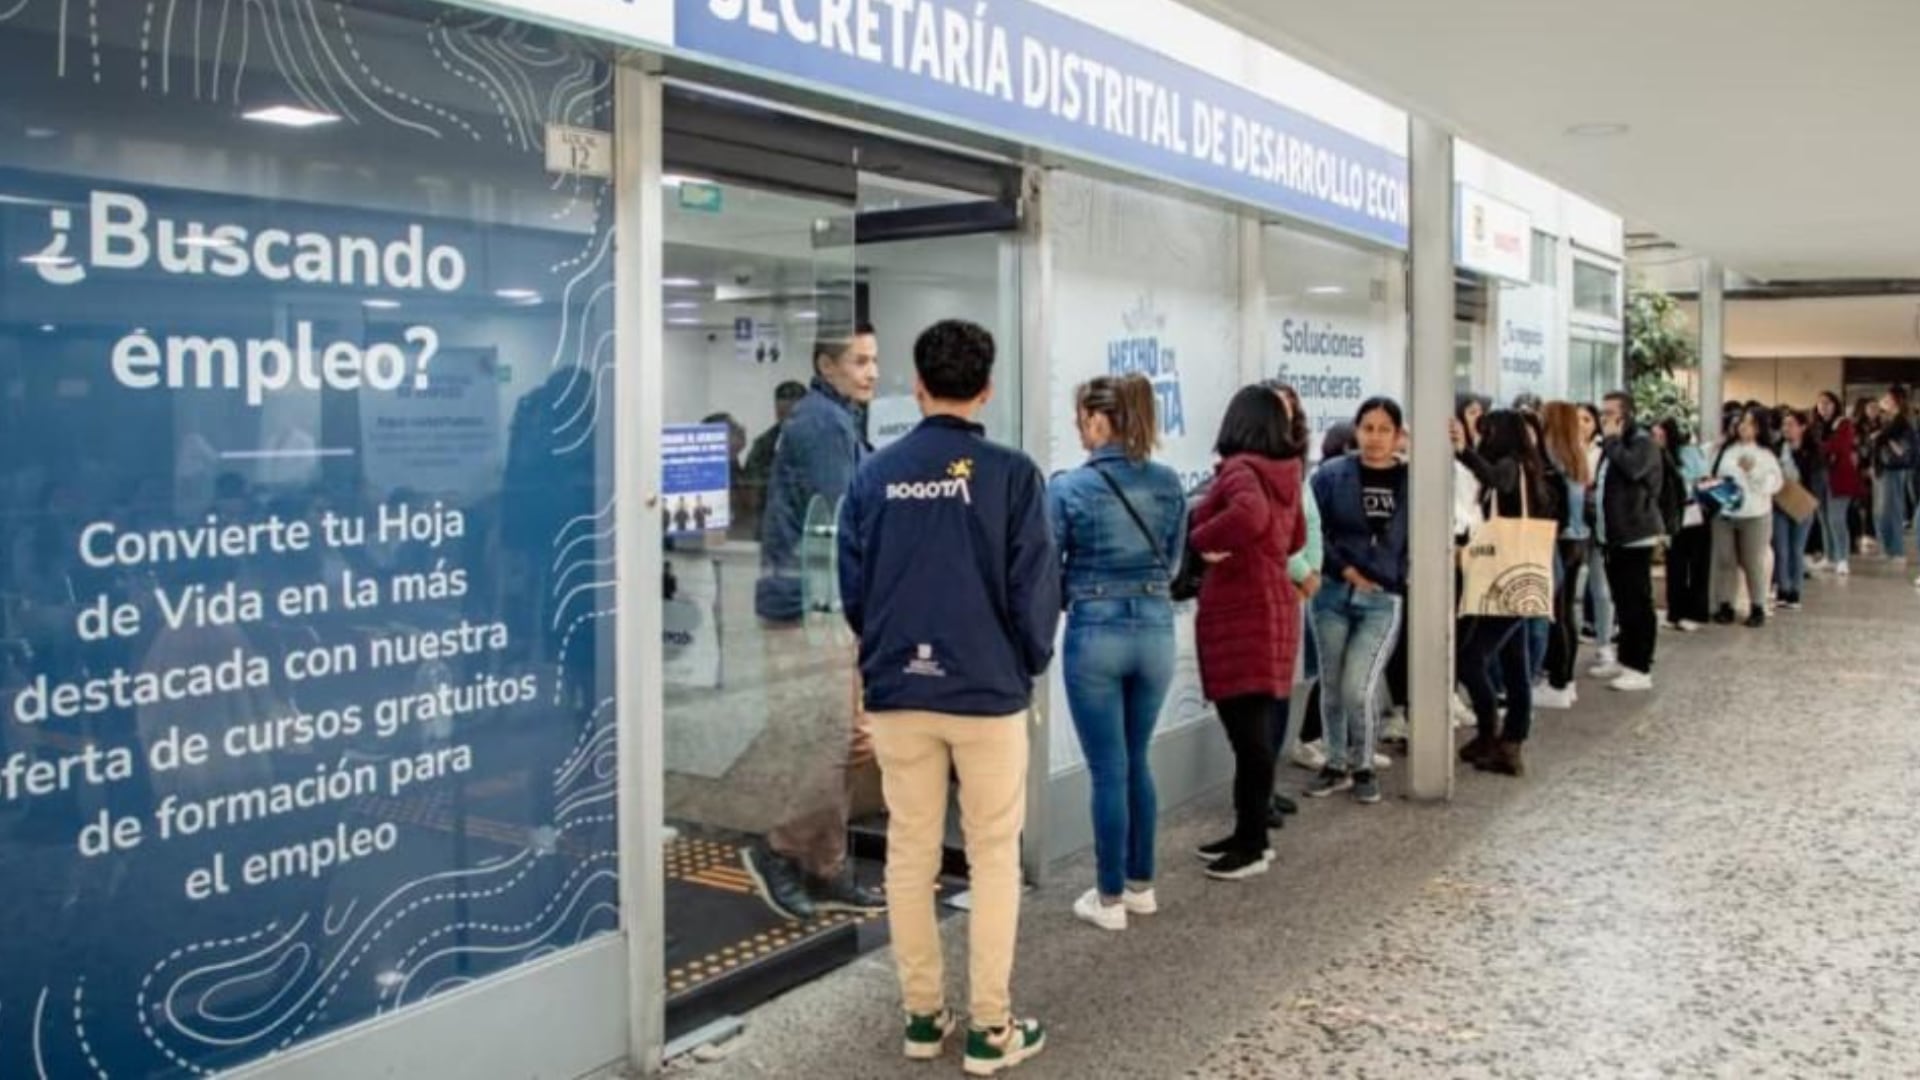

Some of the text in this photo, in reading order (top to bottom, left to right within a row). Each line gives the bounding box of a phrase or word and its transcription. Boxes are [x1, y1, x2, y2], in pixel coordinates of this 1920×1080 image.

[708, 0, 1013, 102] CRETARÍA
[1023, 34, 1187, 154] DISTRITAL
[1193, 99, 1227, 166] DE
[1231, 114, 1364, 211] DESARROLLO
[571, 146, 590, 169] 12
[37, 190, 466, 292] ¿Buscando
[112, 321, 439, 405] empleo?
[1283, 318, 1365, 357] Soluciones
[80, 502, 466, 567] Convierte tu Hoja
[76, 559, 468, 642] de Vida en la más
[14, 619, 509, 724] destacada con nuestra
[0, 672, 537, 801] ferta de cursos gratuitos
[78, 744, 473, 858] de formación para
[185, 821, 398, 900] el empleo
